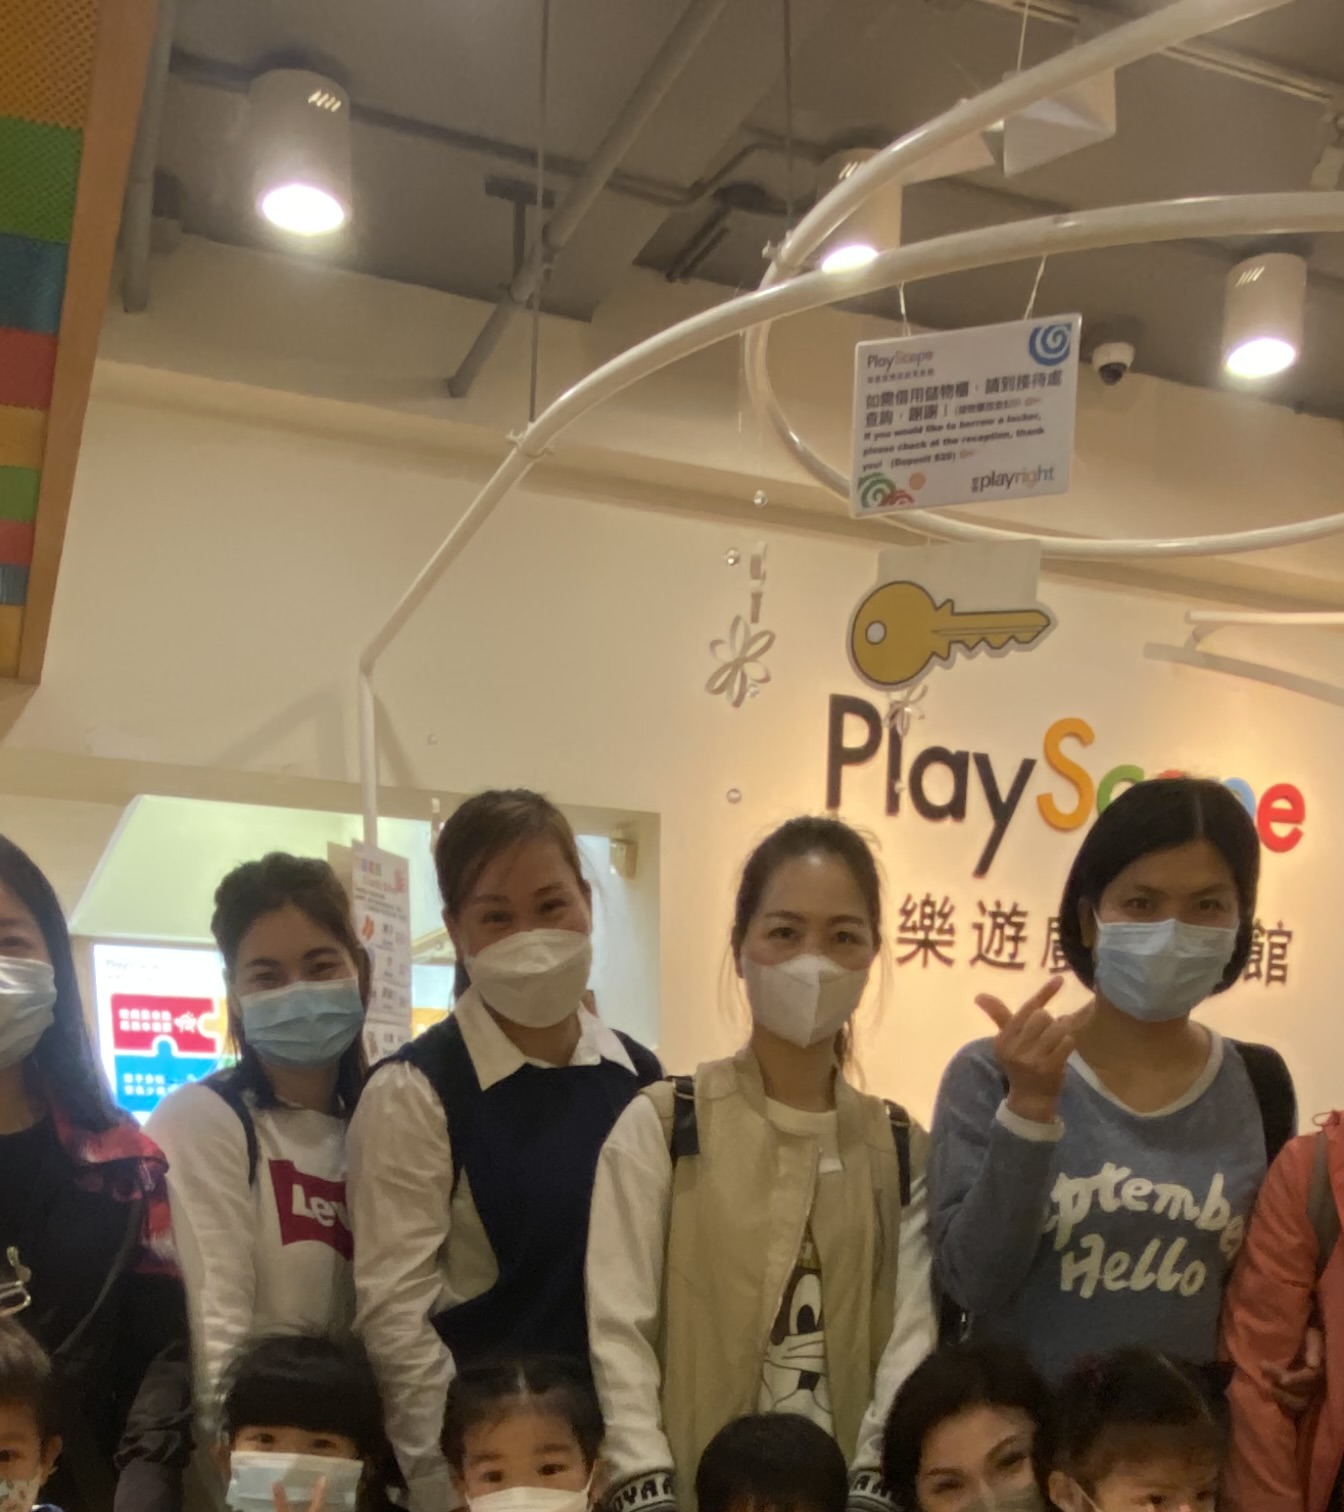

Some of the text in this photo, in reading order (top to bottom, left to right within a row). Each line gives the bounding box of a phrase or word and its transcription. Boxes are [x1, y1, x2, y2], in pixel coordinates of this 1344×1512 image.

[863, 446, 895, 457] please
[897, 440, 928, 451] check
[943, 437, 959, 446] the
[961, 431, 1013, 444] reception,
[1016, 426, 1045, 437] thank
[874, 431, 891, 441] you
[894, 426, 923, 437] would
[926, 423, 944, 433] like
[946, 422, 956, 431] to
[959, 418, 995, 430] borrow
[980, 464, 1055, 492] playright
[1061, 1234, 1206, 1299] Hello
